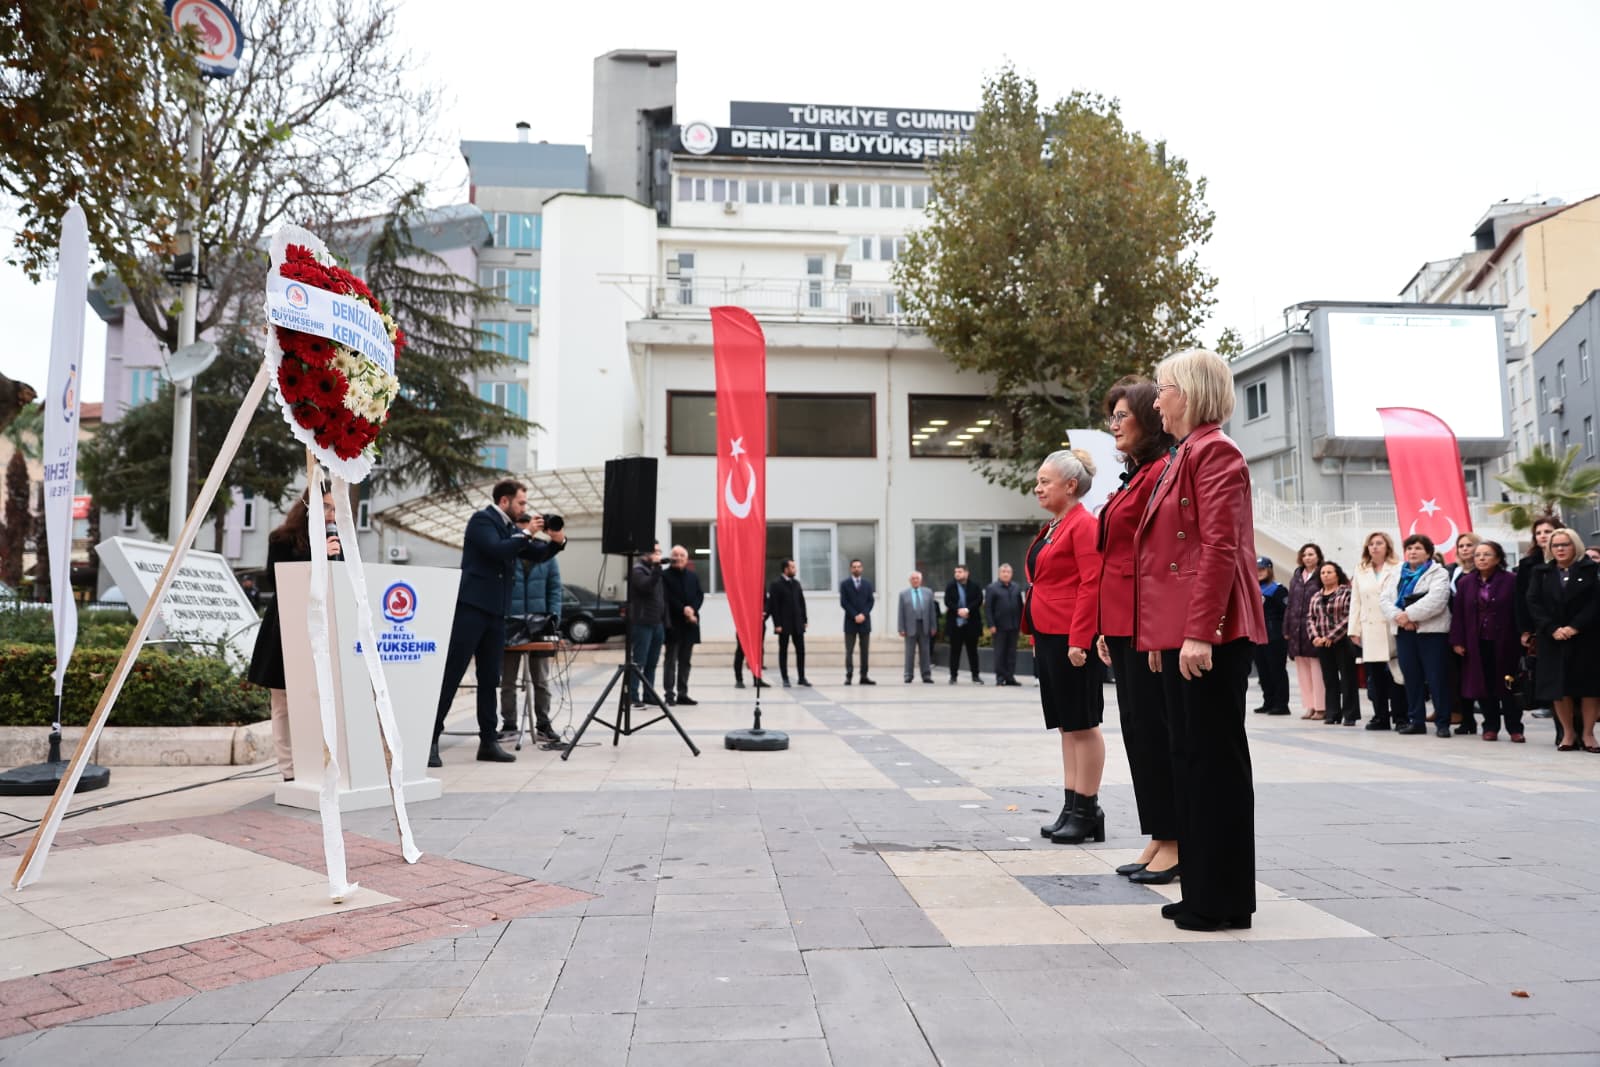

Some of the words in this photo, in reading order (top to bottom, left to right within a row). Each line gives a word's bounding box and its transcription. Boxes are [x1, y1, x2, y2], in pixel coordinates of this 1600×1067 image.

[789, 105, 888, 127] TÜRKİYE
[896, 111, 976, 131] CUMHU
[731, 130, 822, 152] DENİZLİ
[332, 300, 371, 333] DENİZLİ
[332, 323, 361, 350] KENT
